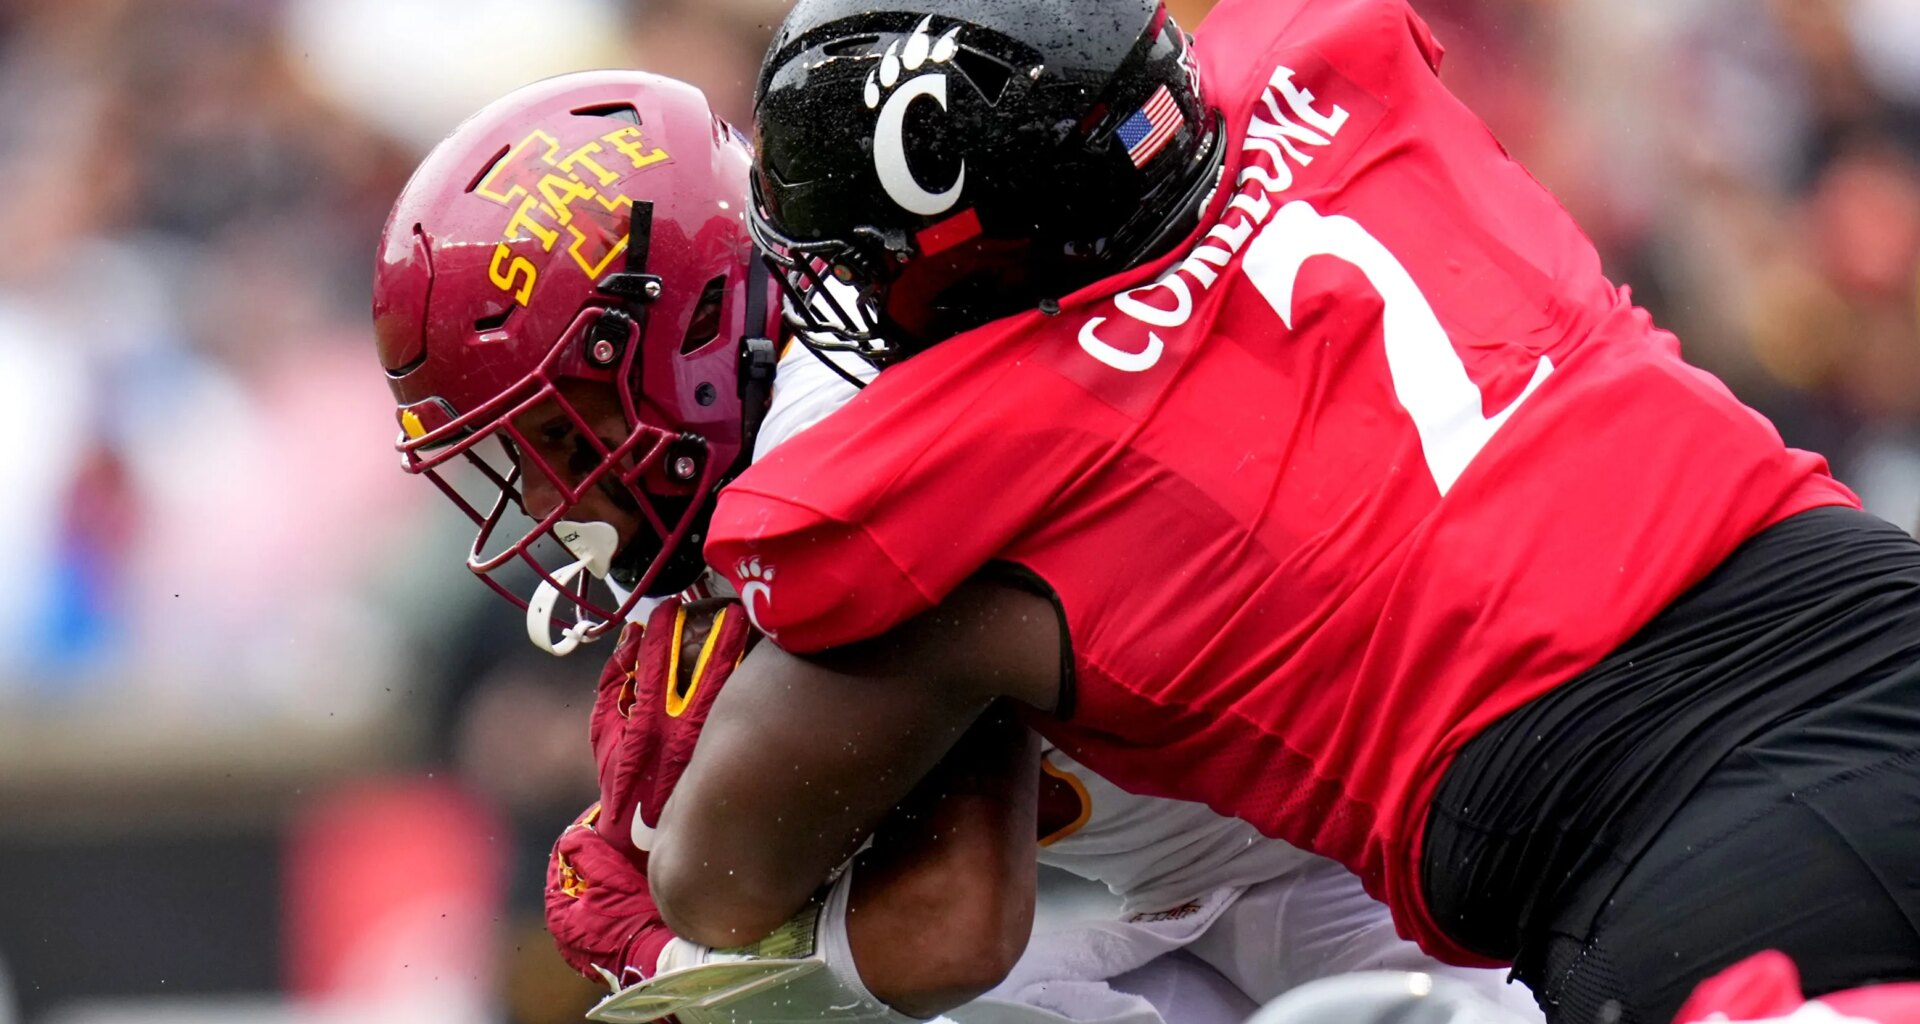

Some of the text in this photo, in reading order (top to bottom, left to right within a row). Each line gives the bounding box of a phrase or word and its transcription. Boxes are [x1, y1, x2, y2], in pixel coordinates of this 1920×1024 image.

[489, 126, 670, 307] STATE
[873, 74, 965, 215] C
[1241, 200, 1555, 498] 2
